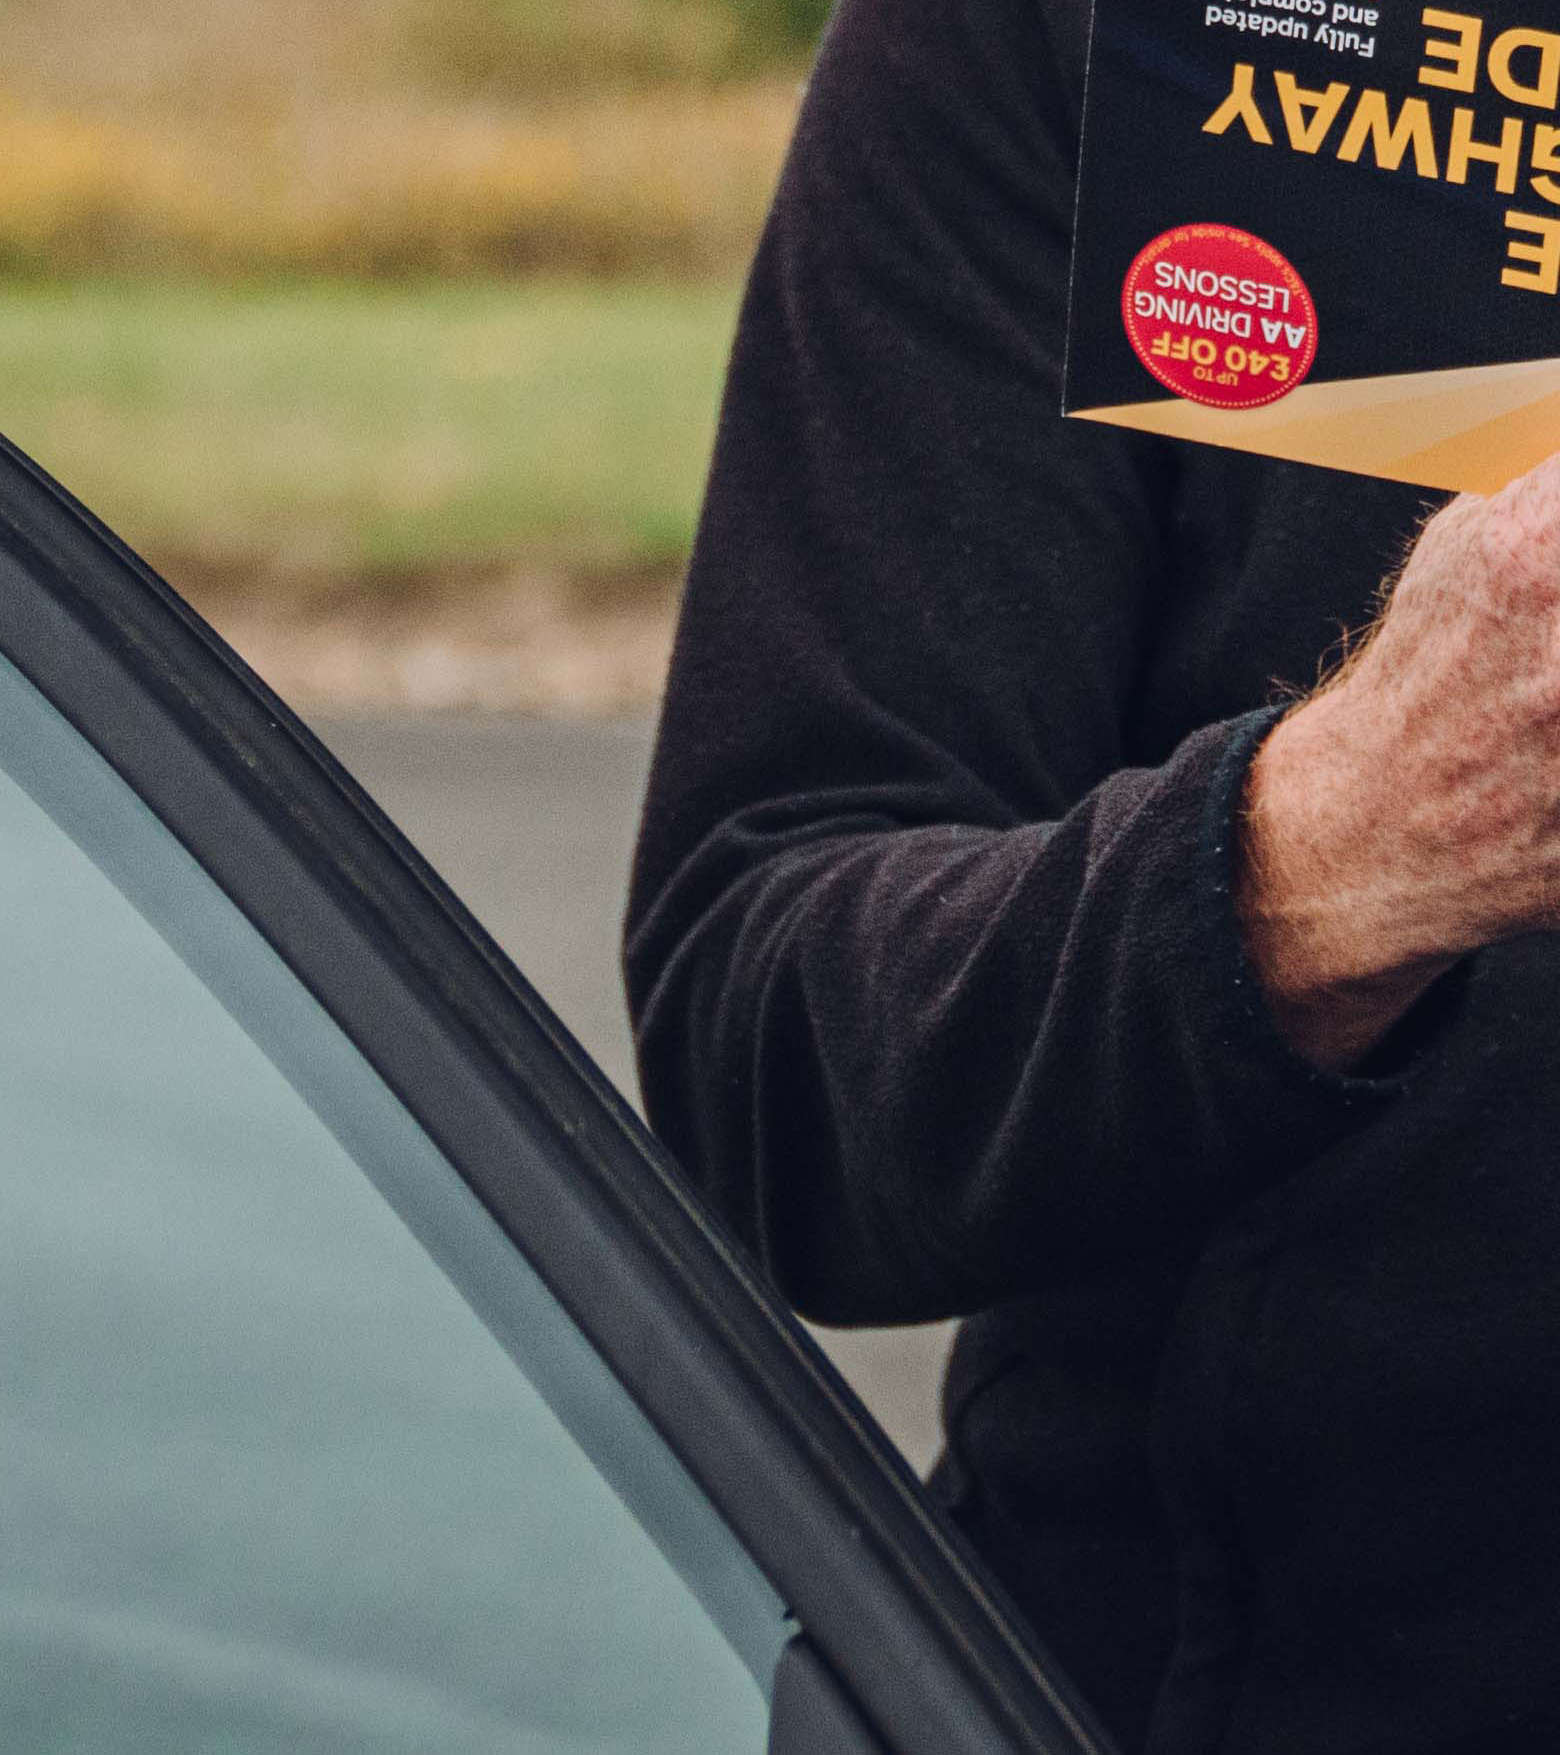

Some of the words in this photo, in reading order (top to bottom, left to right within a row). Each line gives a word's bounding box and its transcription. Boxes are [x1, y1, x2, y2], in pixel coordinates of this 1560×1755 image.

[1205, 5, 1309, 42] updated
[1332, 3, 1378, 28] and
[1316, 21, 1375, 57] Fully
[1154, 261, 1290, 313] LESSONS
[1134, 291, 1252, 339] DRIVING
[1150, 331, 1217, 365] OFF
[1260, 317, 1307, 349] AA
[1192, 366, 1215, 382] TO
[1216, 372, 1238, 387] UP
[1224, 344, 1291, 381] £40
